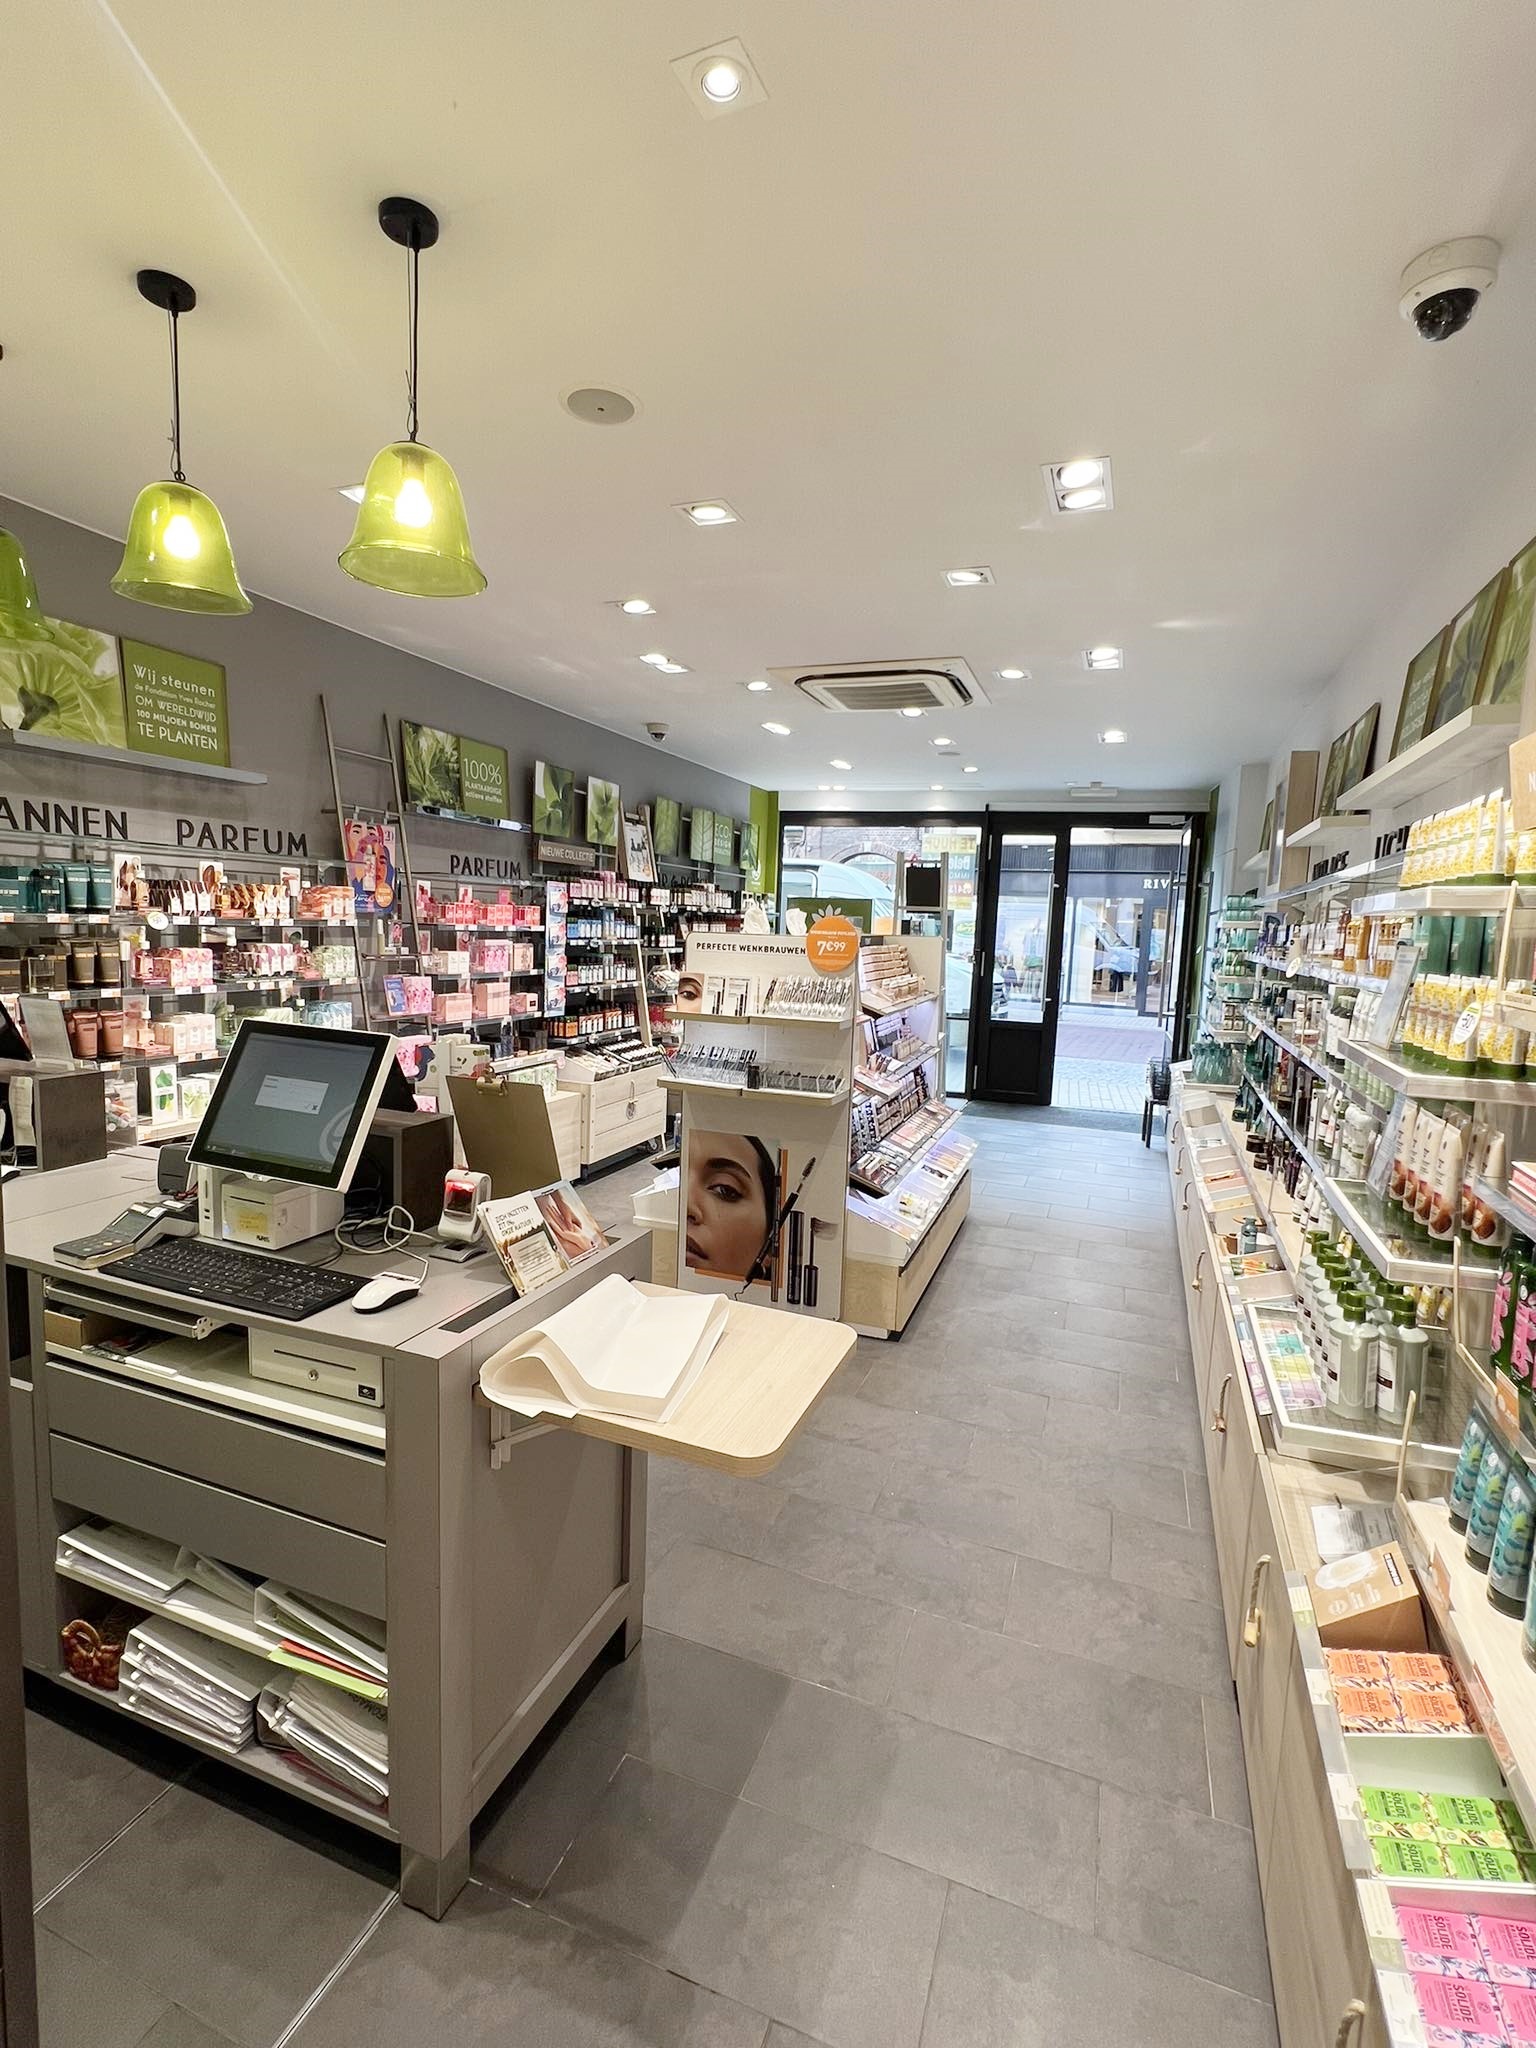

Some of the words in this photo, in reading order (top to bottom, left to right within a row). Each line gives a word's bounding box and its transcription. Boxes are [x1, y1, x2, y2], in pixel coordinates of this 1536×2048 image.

[133, 663, 157, 685] Wij
[161, 675, 216, 698] steunen
[135, 695, 153, 708] OM
[157, 700, 217, 723] WERELDWIJD
[137, 709, 151, 719] 100
[153, 713, 187, 727] MILJOEN
[137, 721, 155, 738] TE
[159, 726, 218, 751] PLANTEN
[463, 758, 503, 785] 100%
[176, 818, 308, 858] PARFUM
[541, 845, 564, 859] NIEUWE
[450, 854, 521, 881] PARFUM
[696, 942, 737, 952] PERFECTE
[739, 944, 807, 955] WENKBRAUWEN
[1391, 1792, 1409, 1819] SOLIDE
[1462, 1799, 1481, 1827] SOLIDE
[1406, 1843, 1424, 1873] SOLIDE
[1482, 1852, 1502, 1880] SOLIDE
[1433, 1915, 1452, 1950] SOLIDE
[1516, 1926, 1536, 1960] SOLIDE
[1453, 1984, 1474, 2023] SOLIDE
